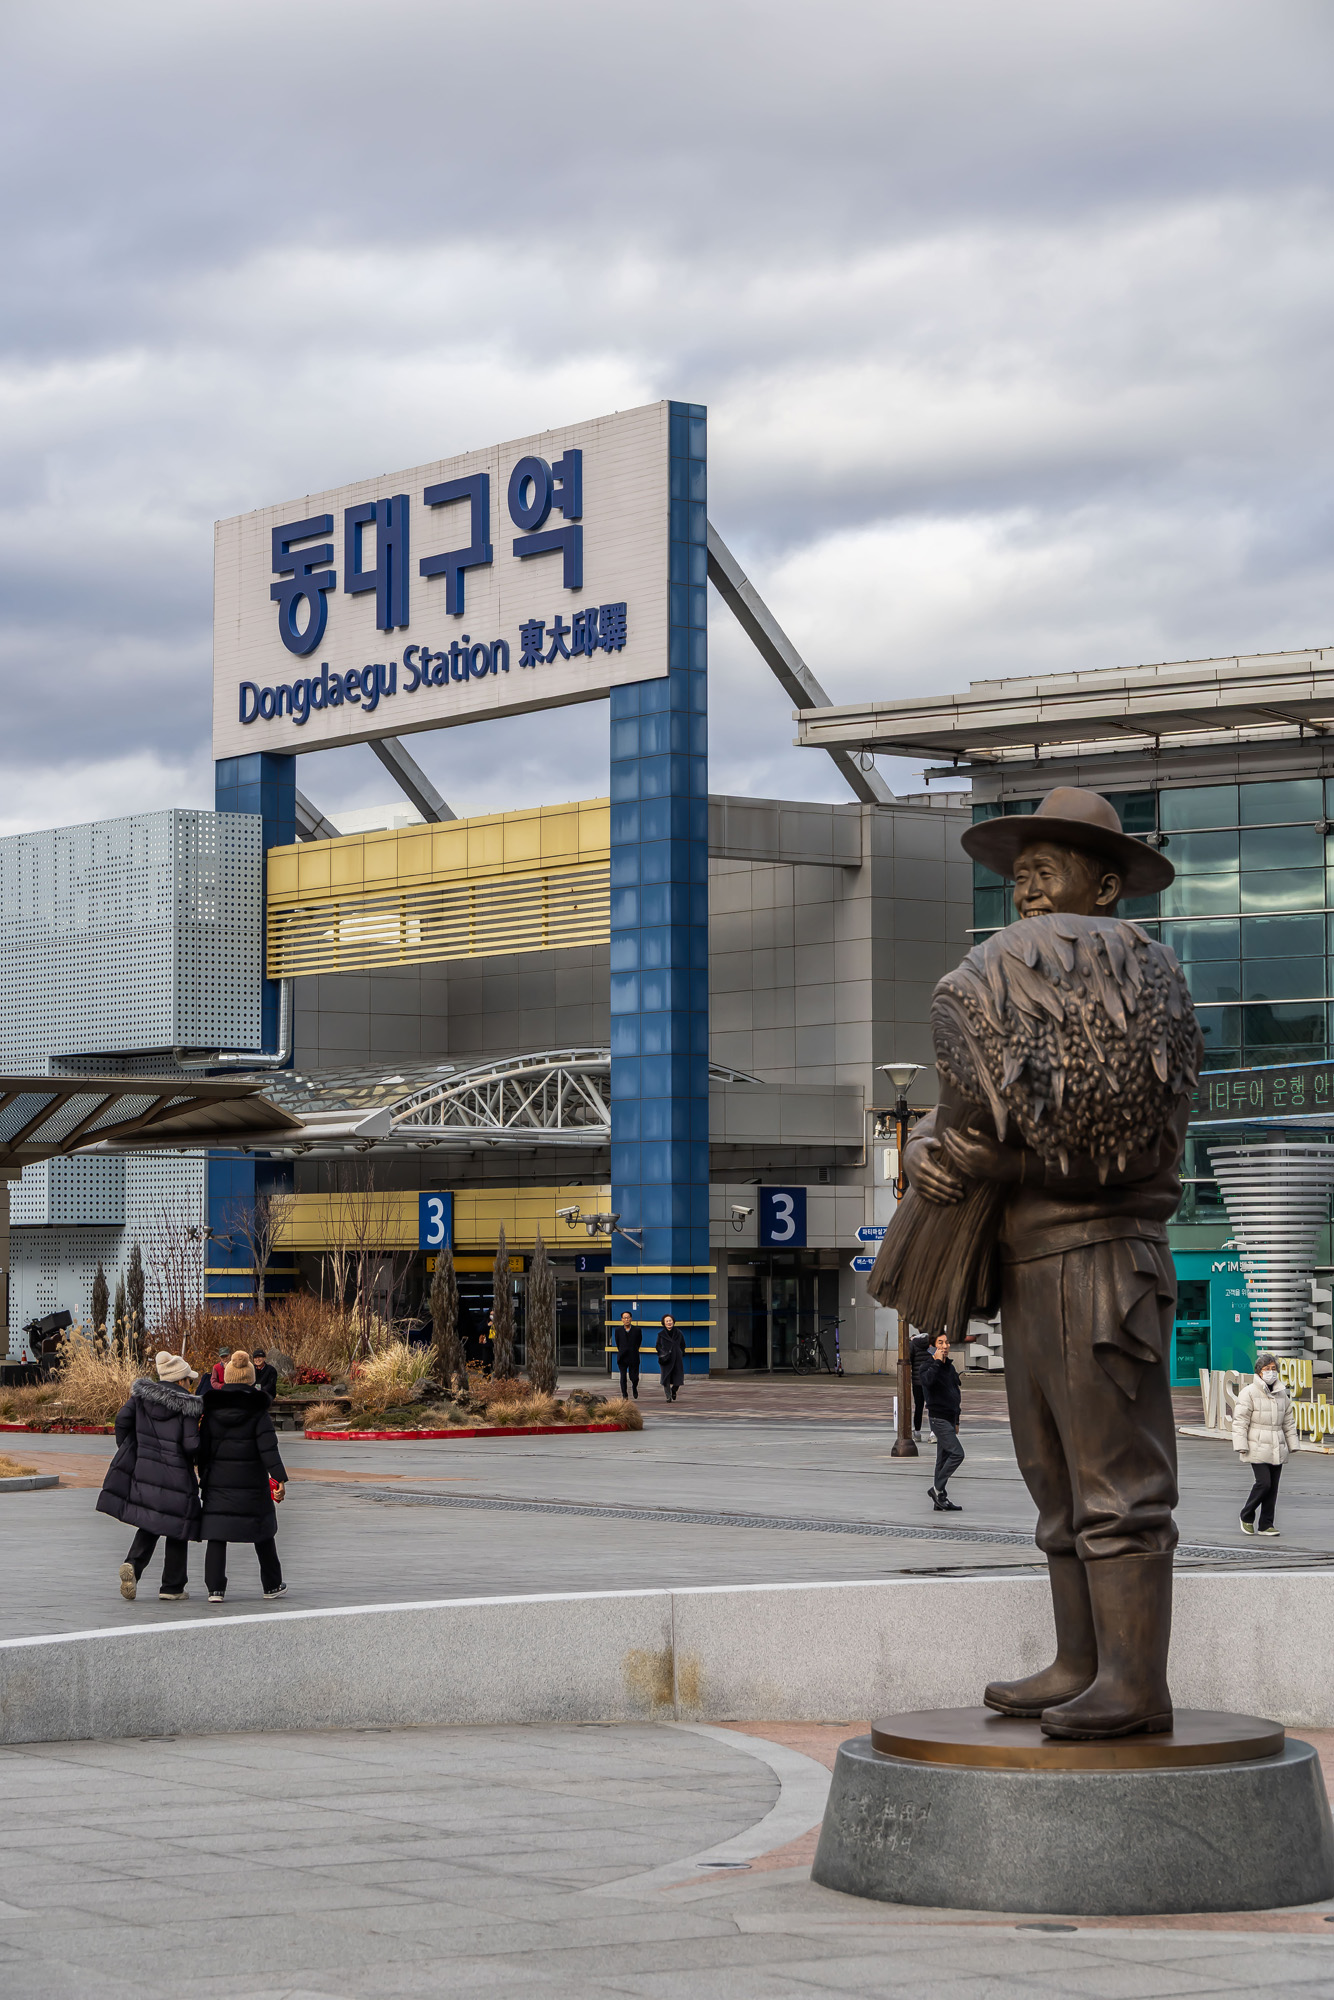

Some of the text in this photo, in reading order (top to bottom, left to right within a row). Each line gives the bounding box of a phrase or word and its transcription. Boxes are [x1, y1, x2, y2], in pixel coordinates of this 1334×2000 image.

[270, 448, 584, 656] 동대구역
[239, 601, 628, 725] Dongdaegu Station 東大邱驛
[1272, 1074, 1306, 1107] 은행
[1314, 1072, 1334, 1104] 안
[427, 1197, 445, 1245] 3
[771, 1193, 796, 1241] 3
[581, 1257, 586, 1270] 3
